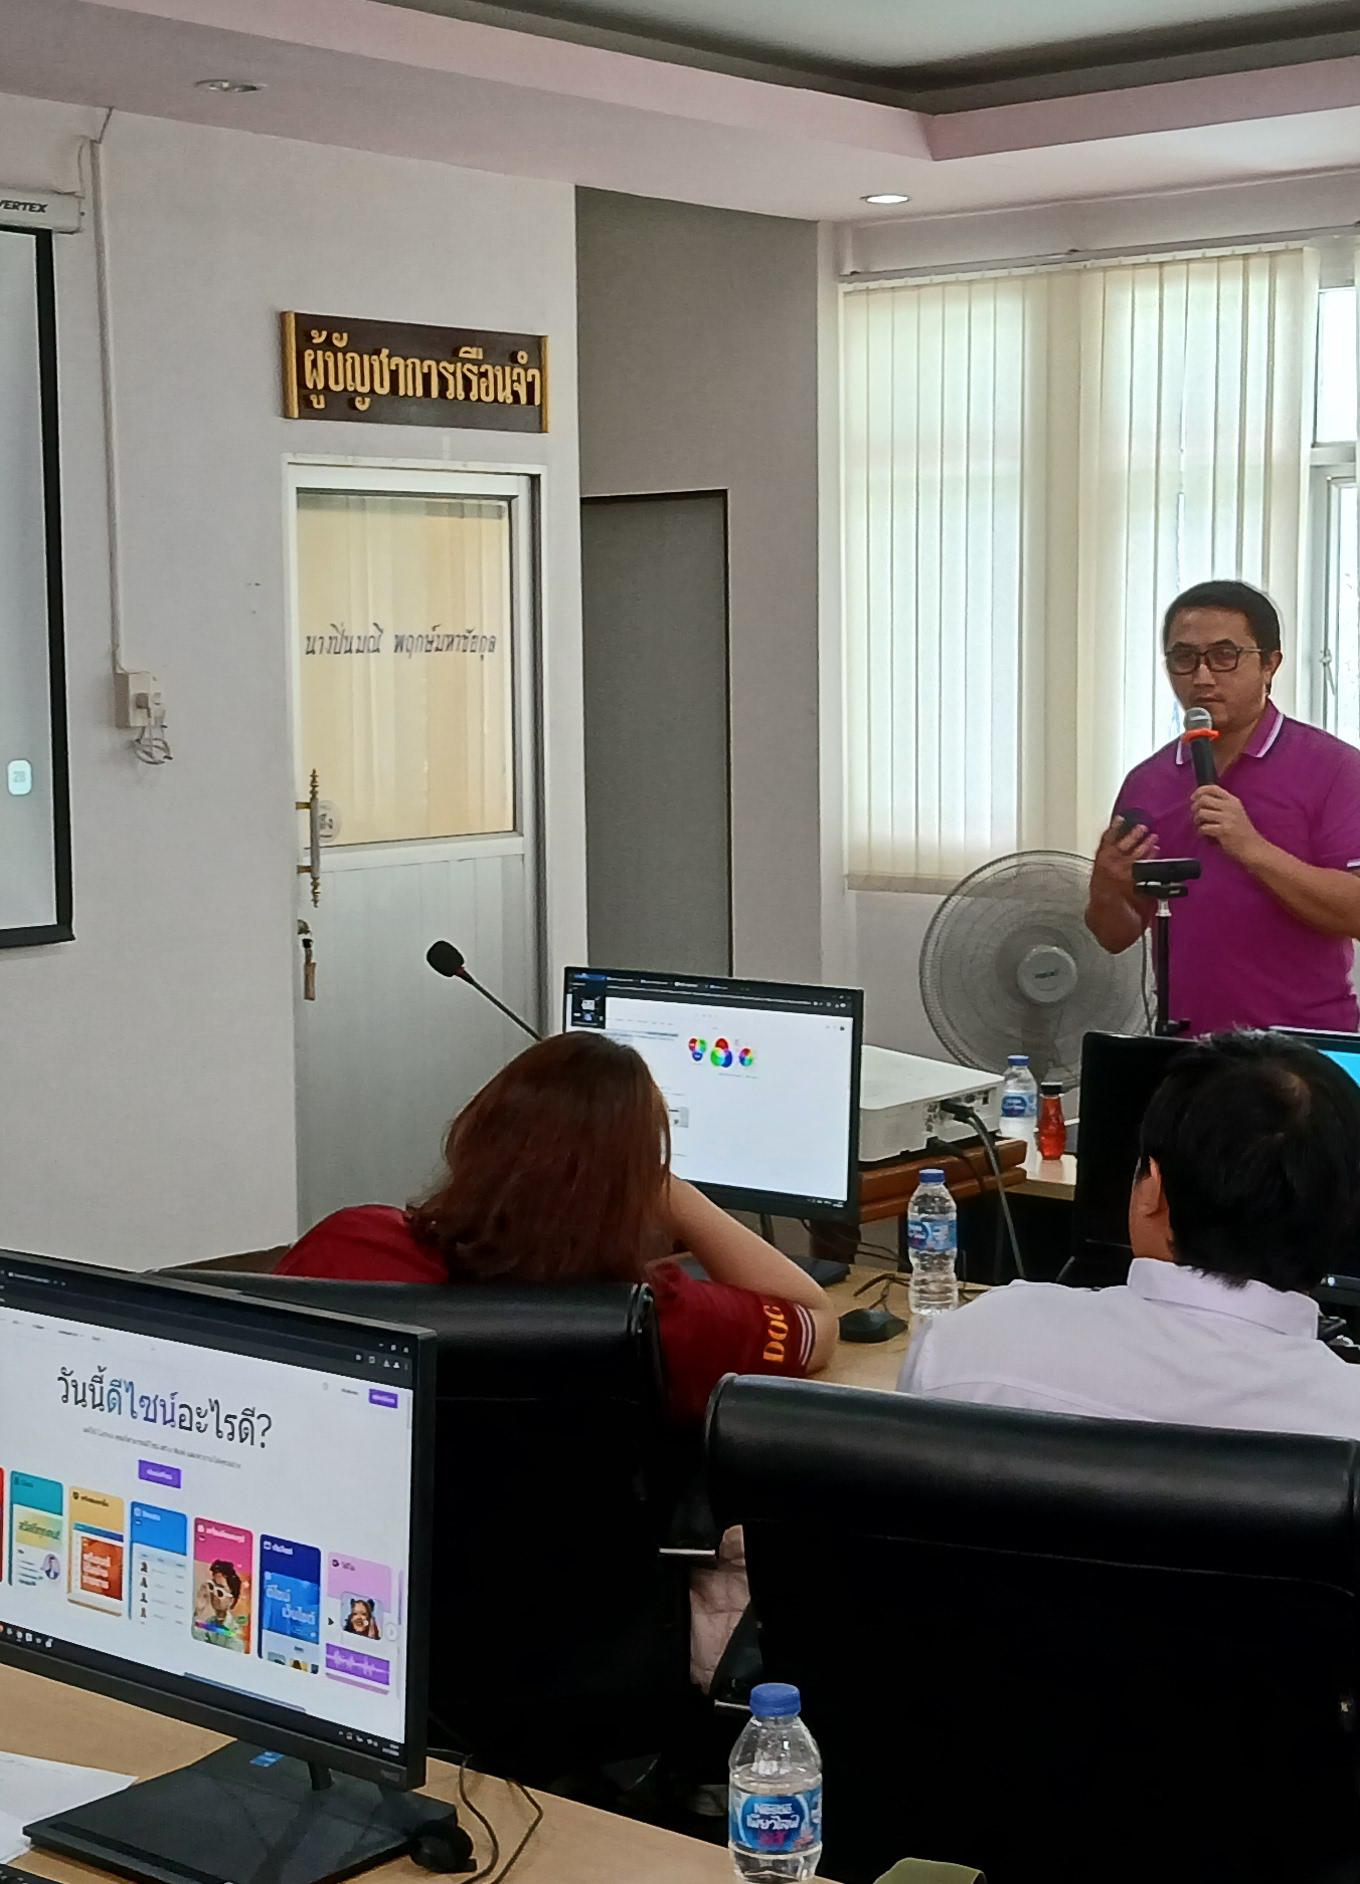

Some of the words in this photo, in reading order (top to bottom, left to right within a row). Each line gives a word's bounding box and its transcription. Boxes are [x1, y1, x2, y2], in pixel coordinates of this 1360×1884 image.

[303, 329, 541, 412] ผู้บัญชาการเรือนจำ
[763, 1304, 789, 1362] DOC
[56, 1364, 272, 1448] วันนี้ดีไซน์อะไรดี?
